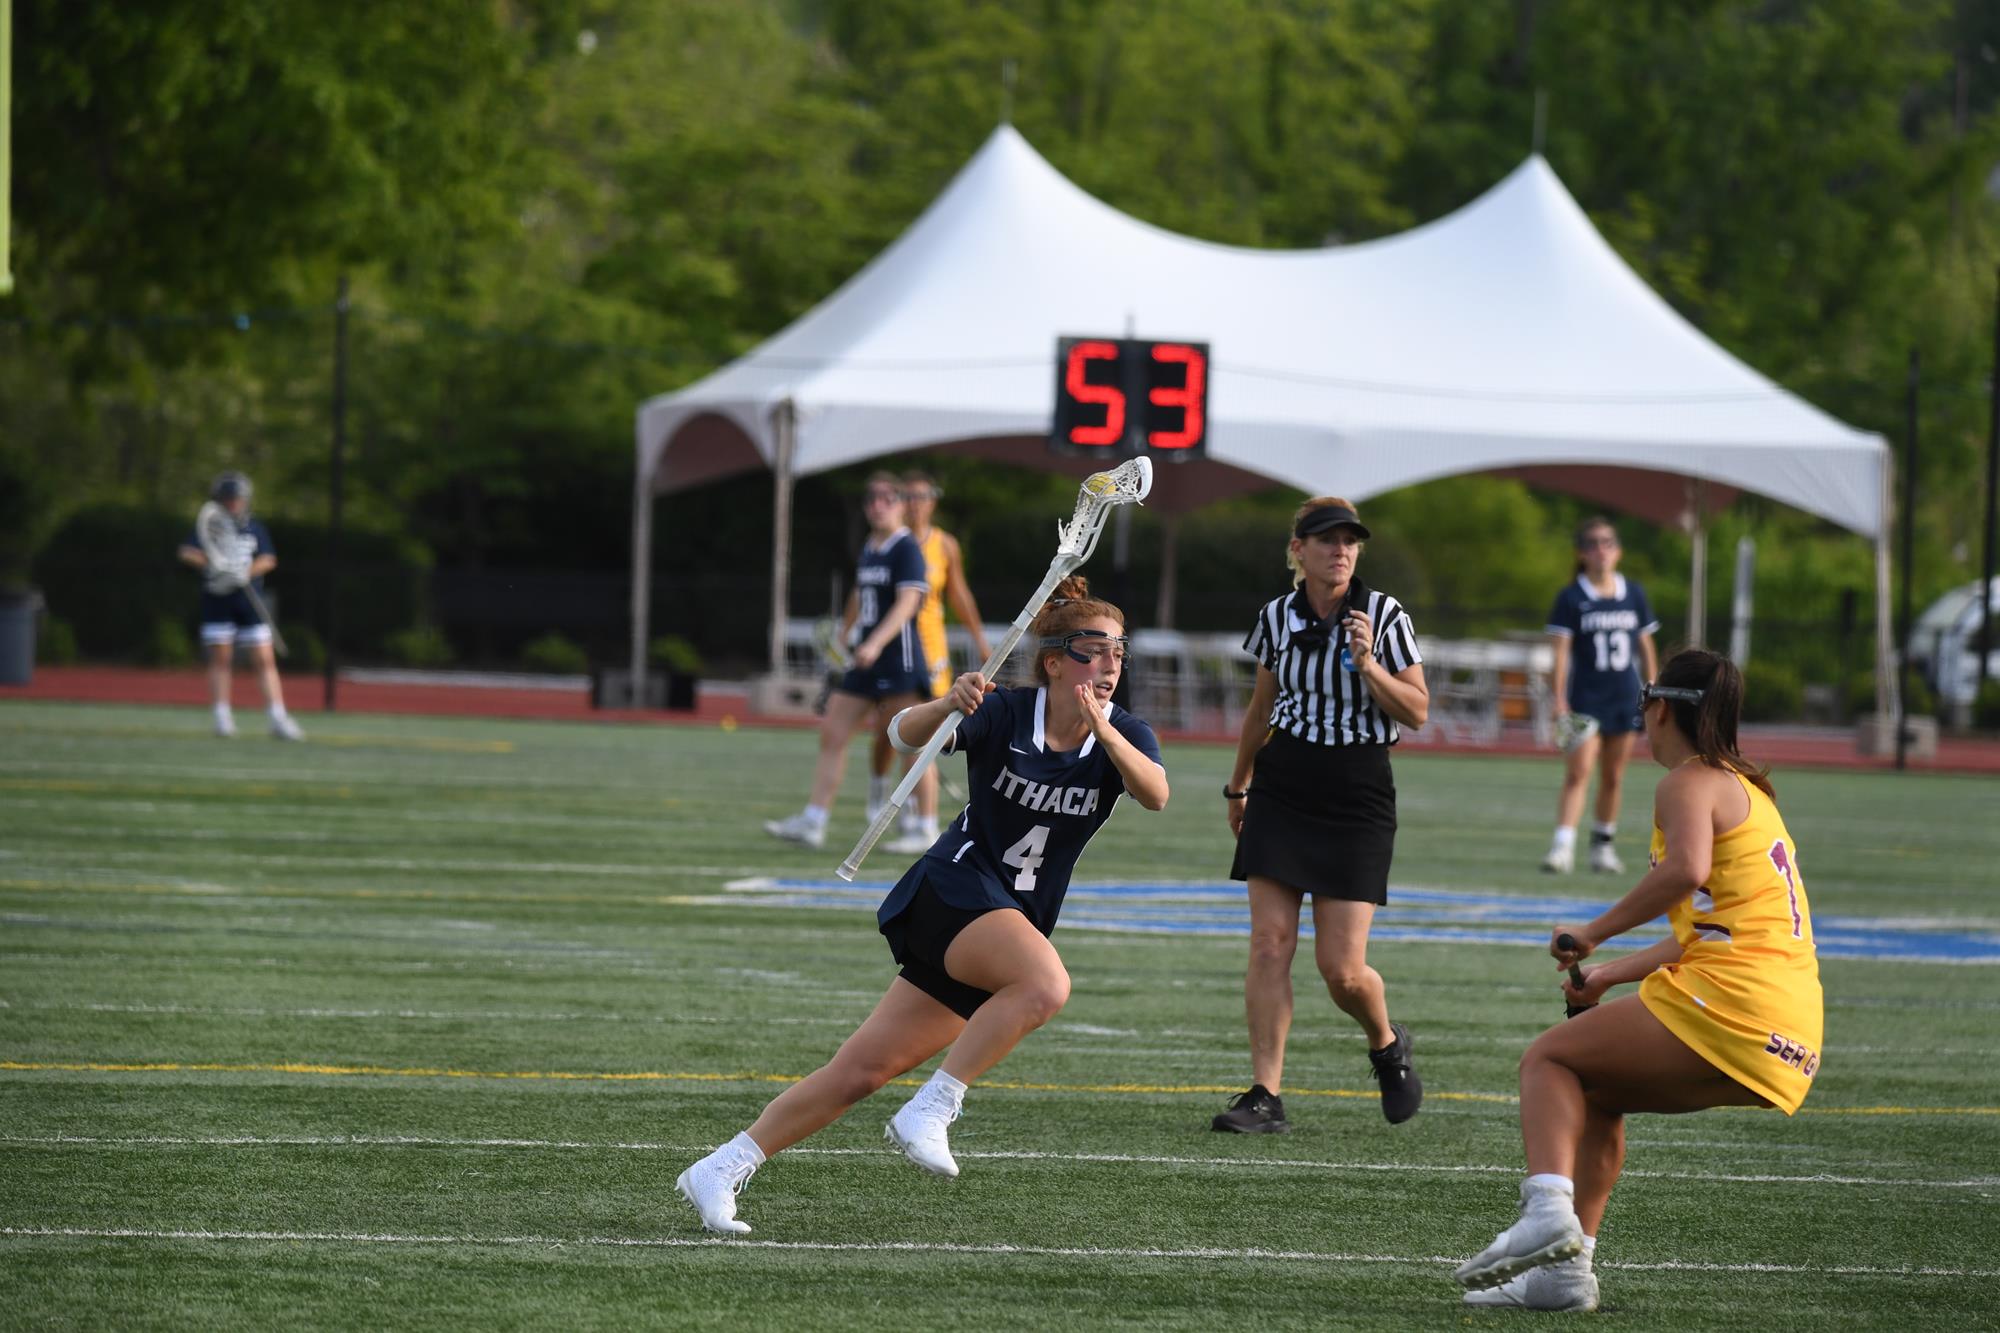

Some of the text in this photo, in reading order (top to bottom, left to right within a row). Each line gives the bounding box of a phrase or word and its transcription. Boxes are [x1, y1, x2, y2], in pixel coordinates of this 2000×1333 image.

[1066, 340, 1206, 449] 53
[1593, 630, 1631, 672] 13
[992, 765, 1100, 816] ITHACA
[1002, 825, 1050, 891] 4
[1764, 1032, 1807, 1069] SEA
